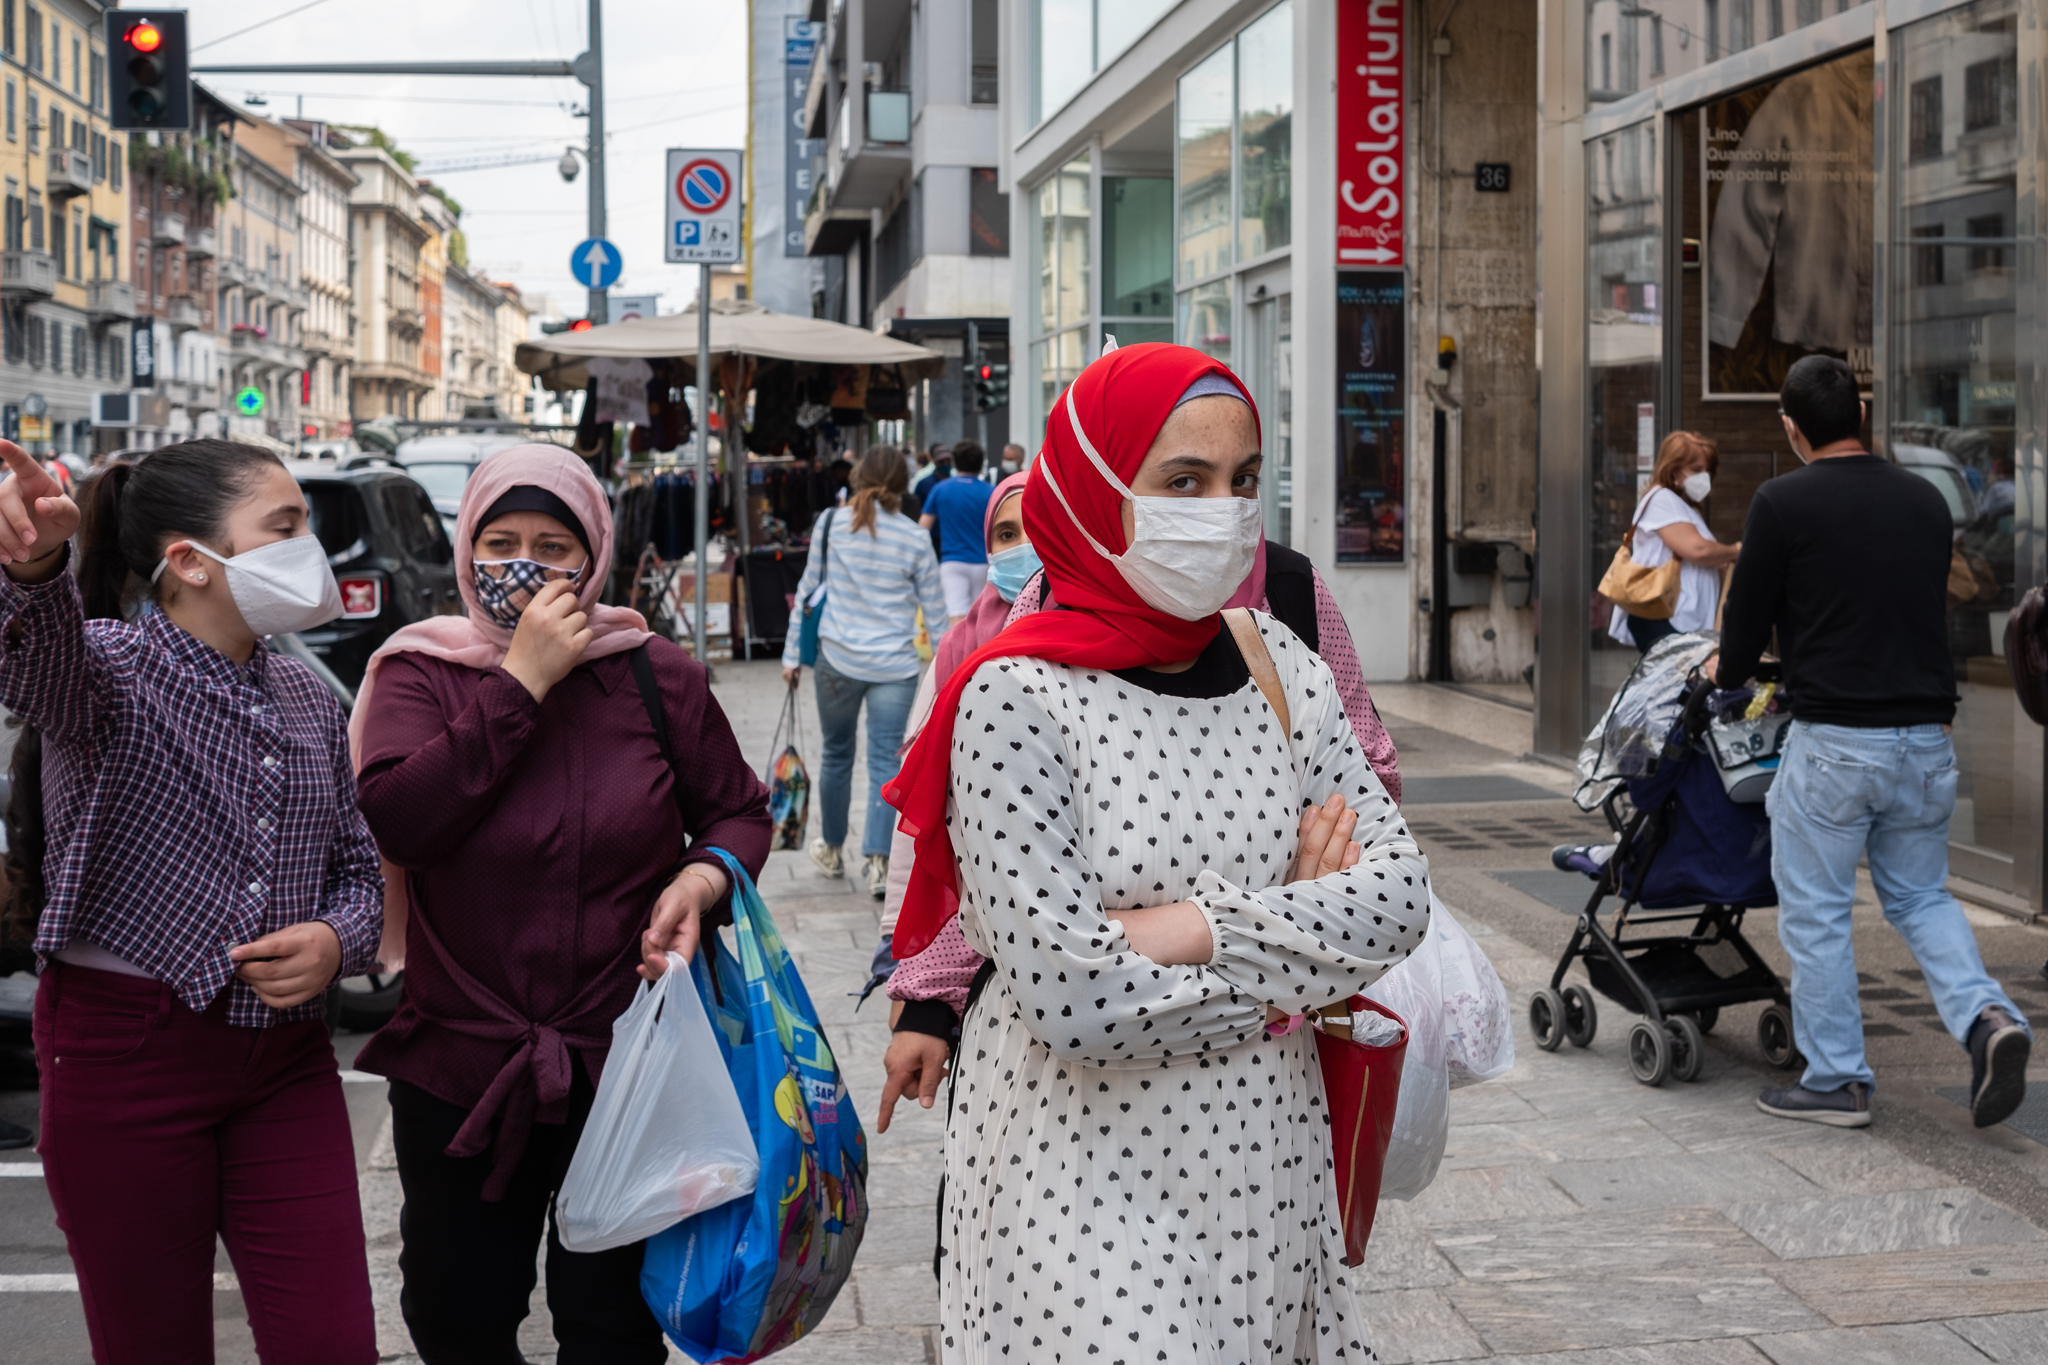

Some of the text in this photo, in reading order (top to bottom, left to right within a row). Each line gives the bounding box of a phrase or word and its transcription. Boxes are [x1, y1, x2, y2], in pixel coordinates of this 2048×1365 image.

[1706, 127, 1744, 142] Lino.
[1706, 147, 1763, 162] Quando
[1765, 148, 1780, 162] lo
[1480, 166, 1506, 189] 36
[1706, 170, 1735, 182] non
[1736, 168, 1778, 183] potrai
[679, 222, 697, 244] P
